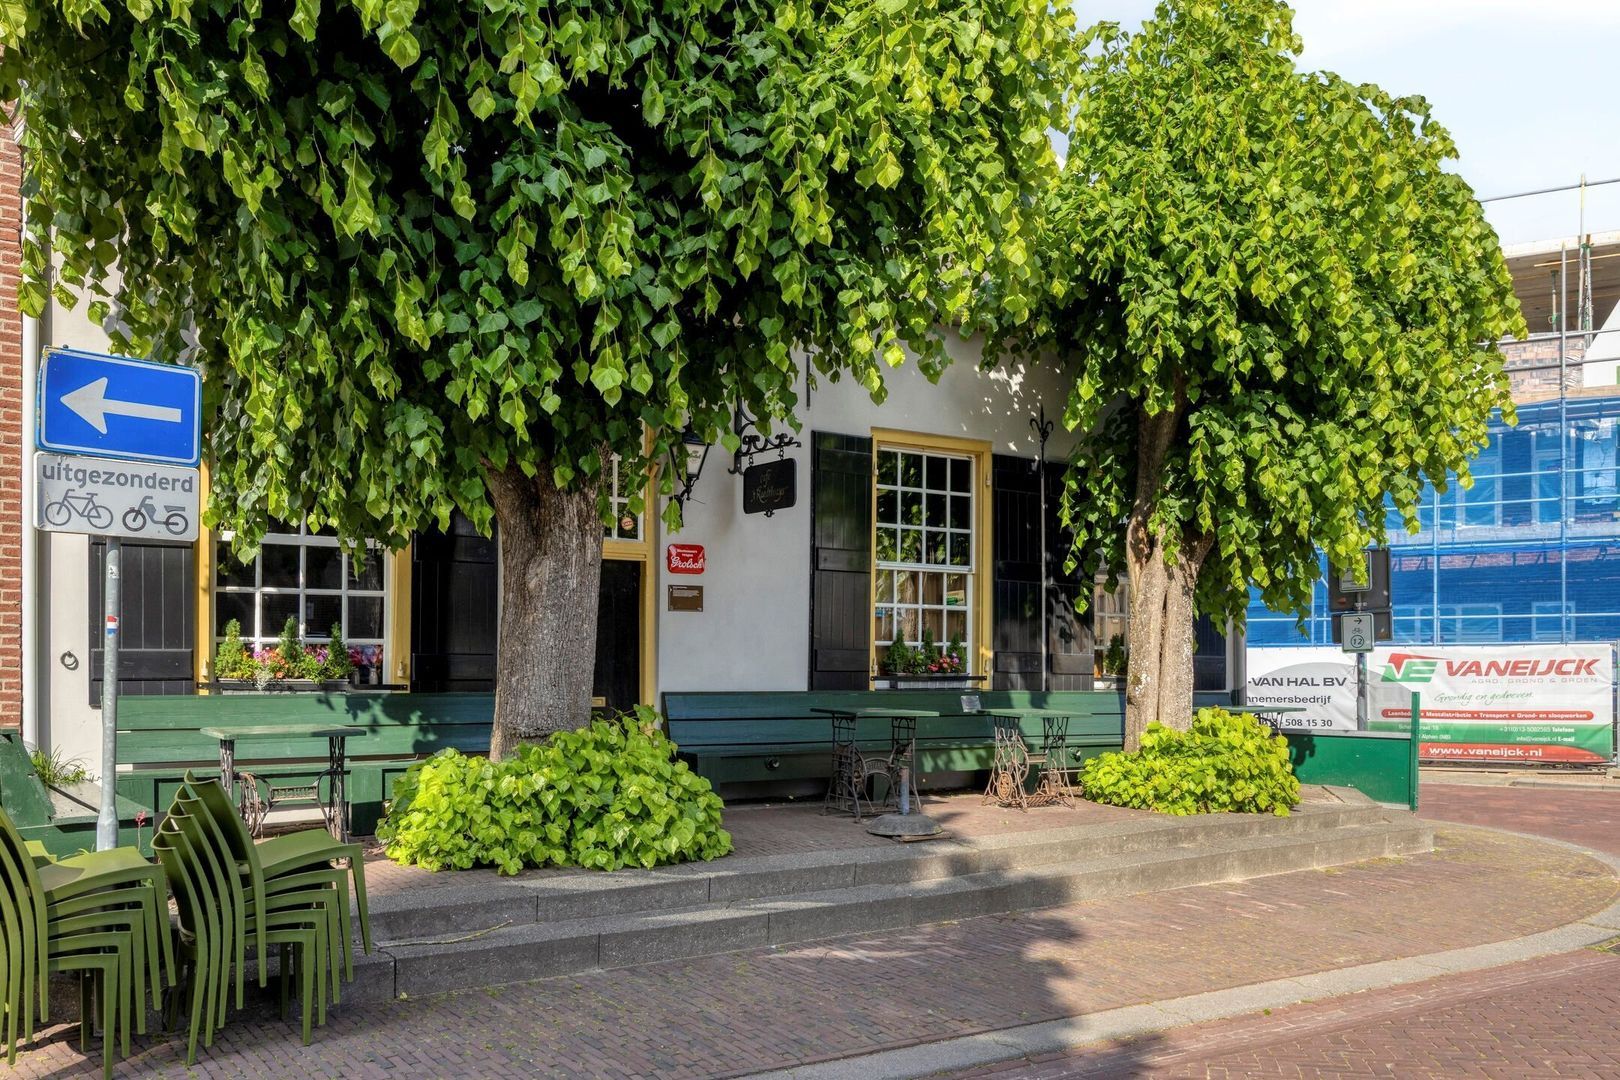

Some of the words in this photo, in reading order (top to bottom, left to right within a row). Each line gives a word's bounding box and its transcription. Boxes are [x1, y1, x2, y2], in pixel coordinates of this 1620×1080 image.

[42, 463, 193, 493] uitgezonderd
[671, 556, 703, 569] Grolsch
[1446, 659, 1600, 677] VANEIJCK
[1287, 677, 1320, 687] HAL
[1323, 678, 1347, 686] BV
[1285, 719, 1303, 727] 508
[1306, 719, 1318, 727] 15
[1319, 719, 1333, 727] 30
[1429, 747, 1543, 757] www.vaneijck.nl
